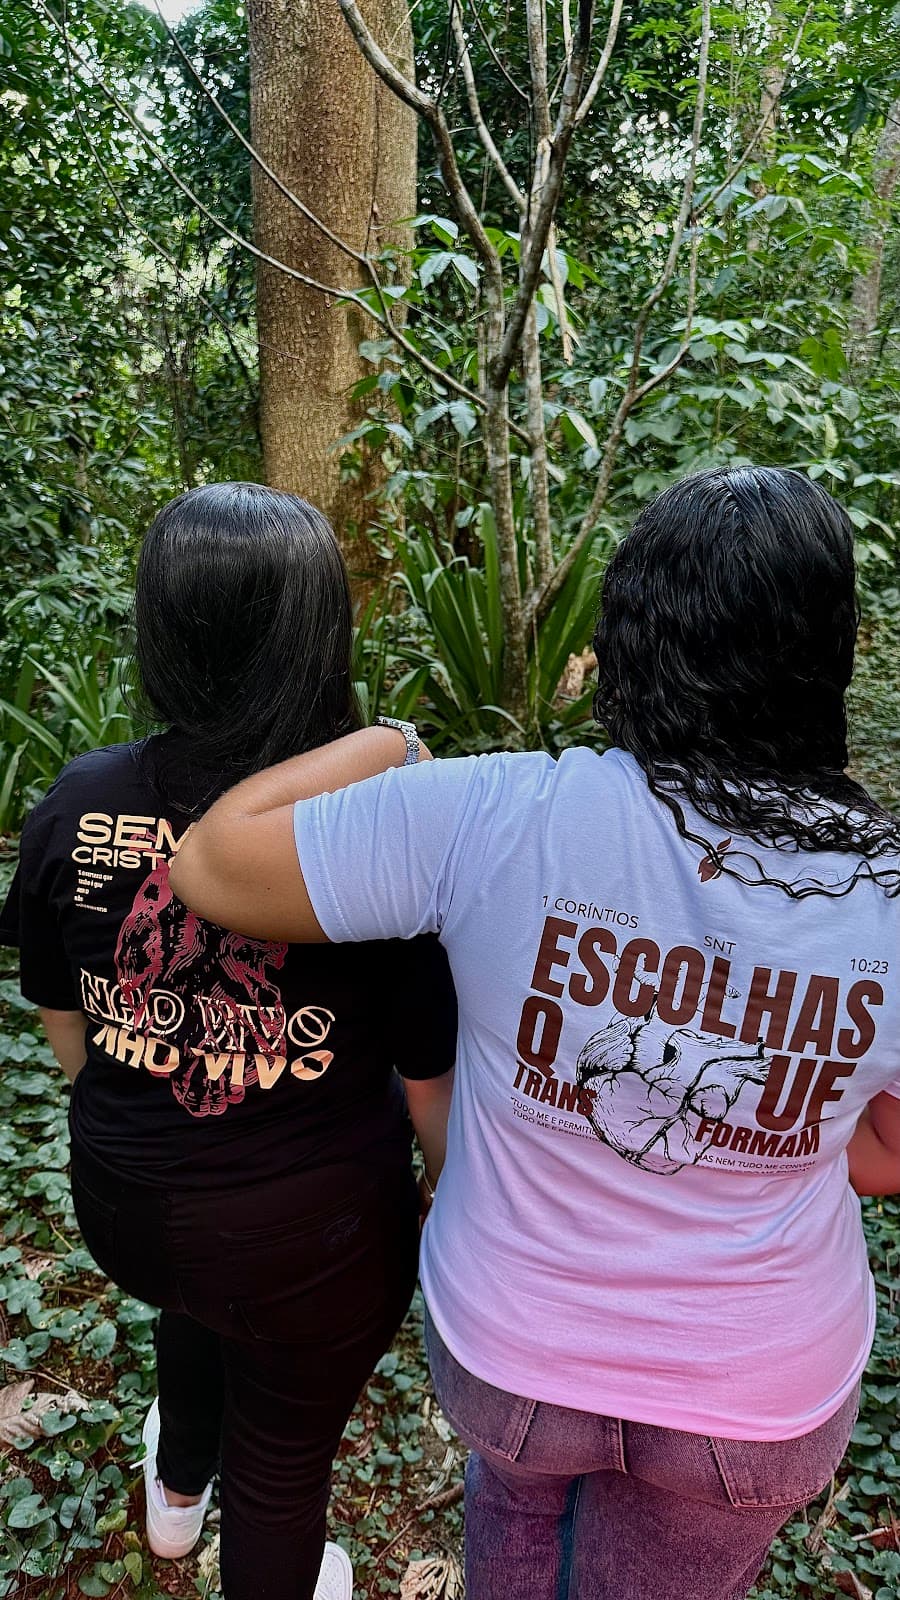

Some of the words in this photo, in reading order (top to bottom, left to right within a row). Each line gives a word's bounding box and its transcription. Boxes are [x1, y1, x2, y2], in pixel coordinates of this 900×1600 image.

[76, 812, 194, 852] SEM
[71, 846, 176, 871] CRIST
[541, 895, 549, 908] 1
[554, 897, 640, 929] CORÍNTIOS
[703, 935, 737, 955] SNT
[850, 958, 889, 975] 10:23
[530, 915, 884, 1060] ESCOLHAS
[516, 996, 564, 1079] Q
[513, 1060, 598, 1116] TRANS
[558, 1119, 597, 1136] PERMITI
[695, 1118, 821, 1158] FORMAM
[715, 1157, 736, 1167] NEM
[738, 1160, 763, 1169] TUDO
